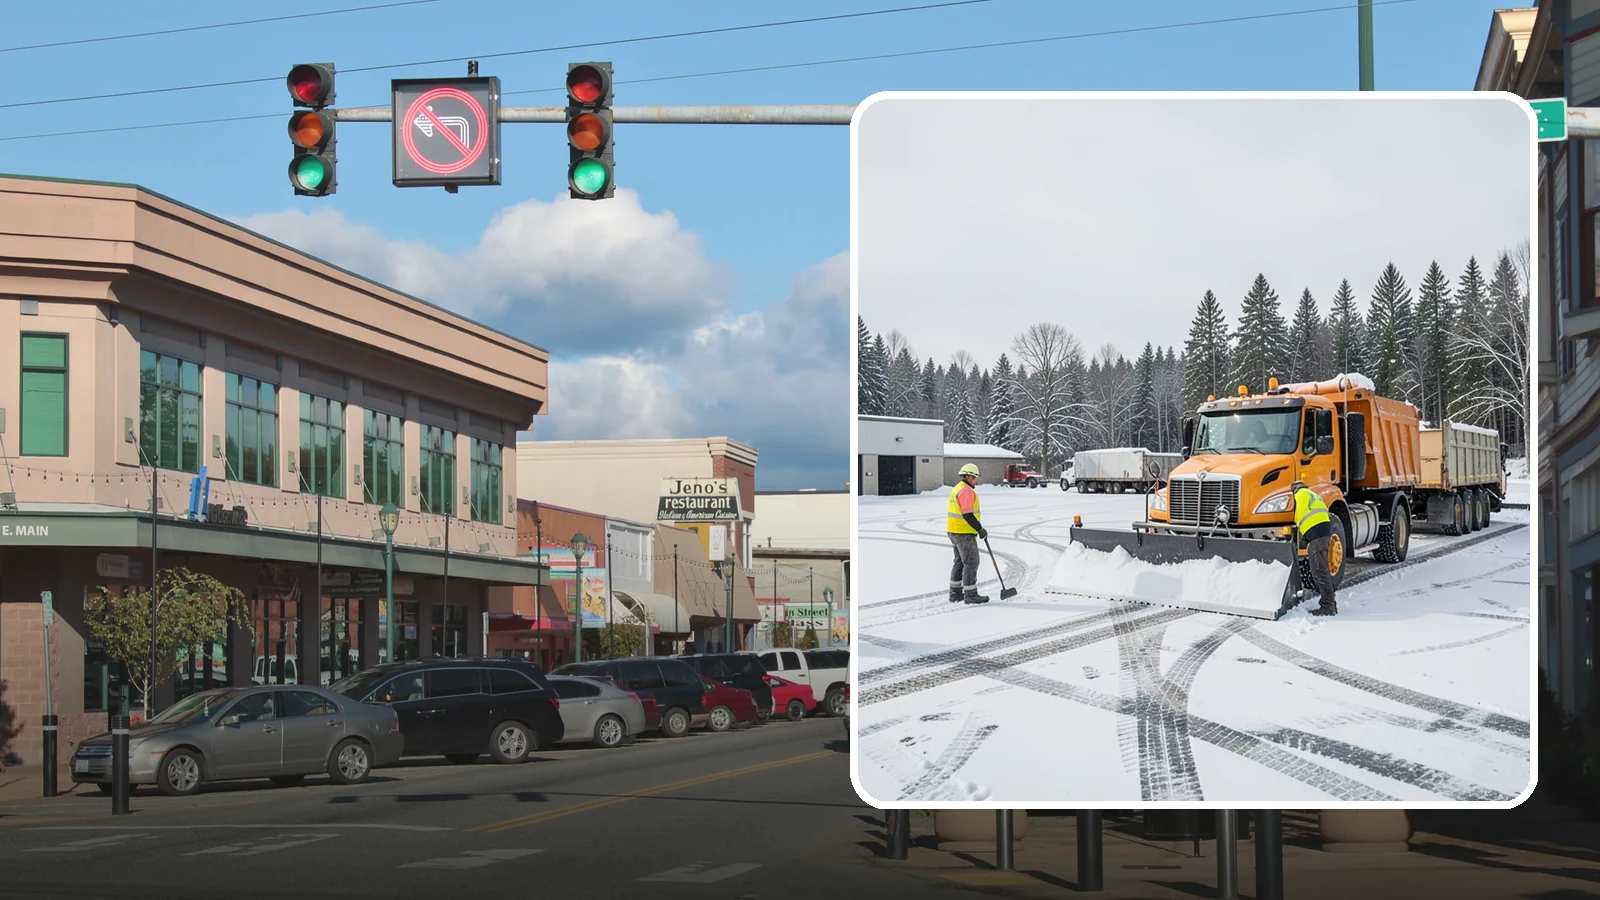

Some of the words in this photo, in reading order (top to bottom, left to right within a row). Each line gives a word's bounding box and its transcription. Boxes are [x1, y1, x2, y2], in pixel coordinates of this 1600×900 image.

[669, 480, 727, 494] Jeno's
[665, 496, 731, 509] restaurant
[658, 510, 681, 520] Italian
[685, 509, 714, 519] American
[714, 509, 737, 519] Cuisine
[2, 525, 13, 536] E.
[15, 525, 49, 536] MAIN
[797, 608, 828, 617] Street
[791, 619, 824, 627] lass
